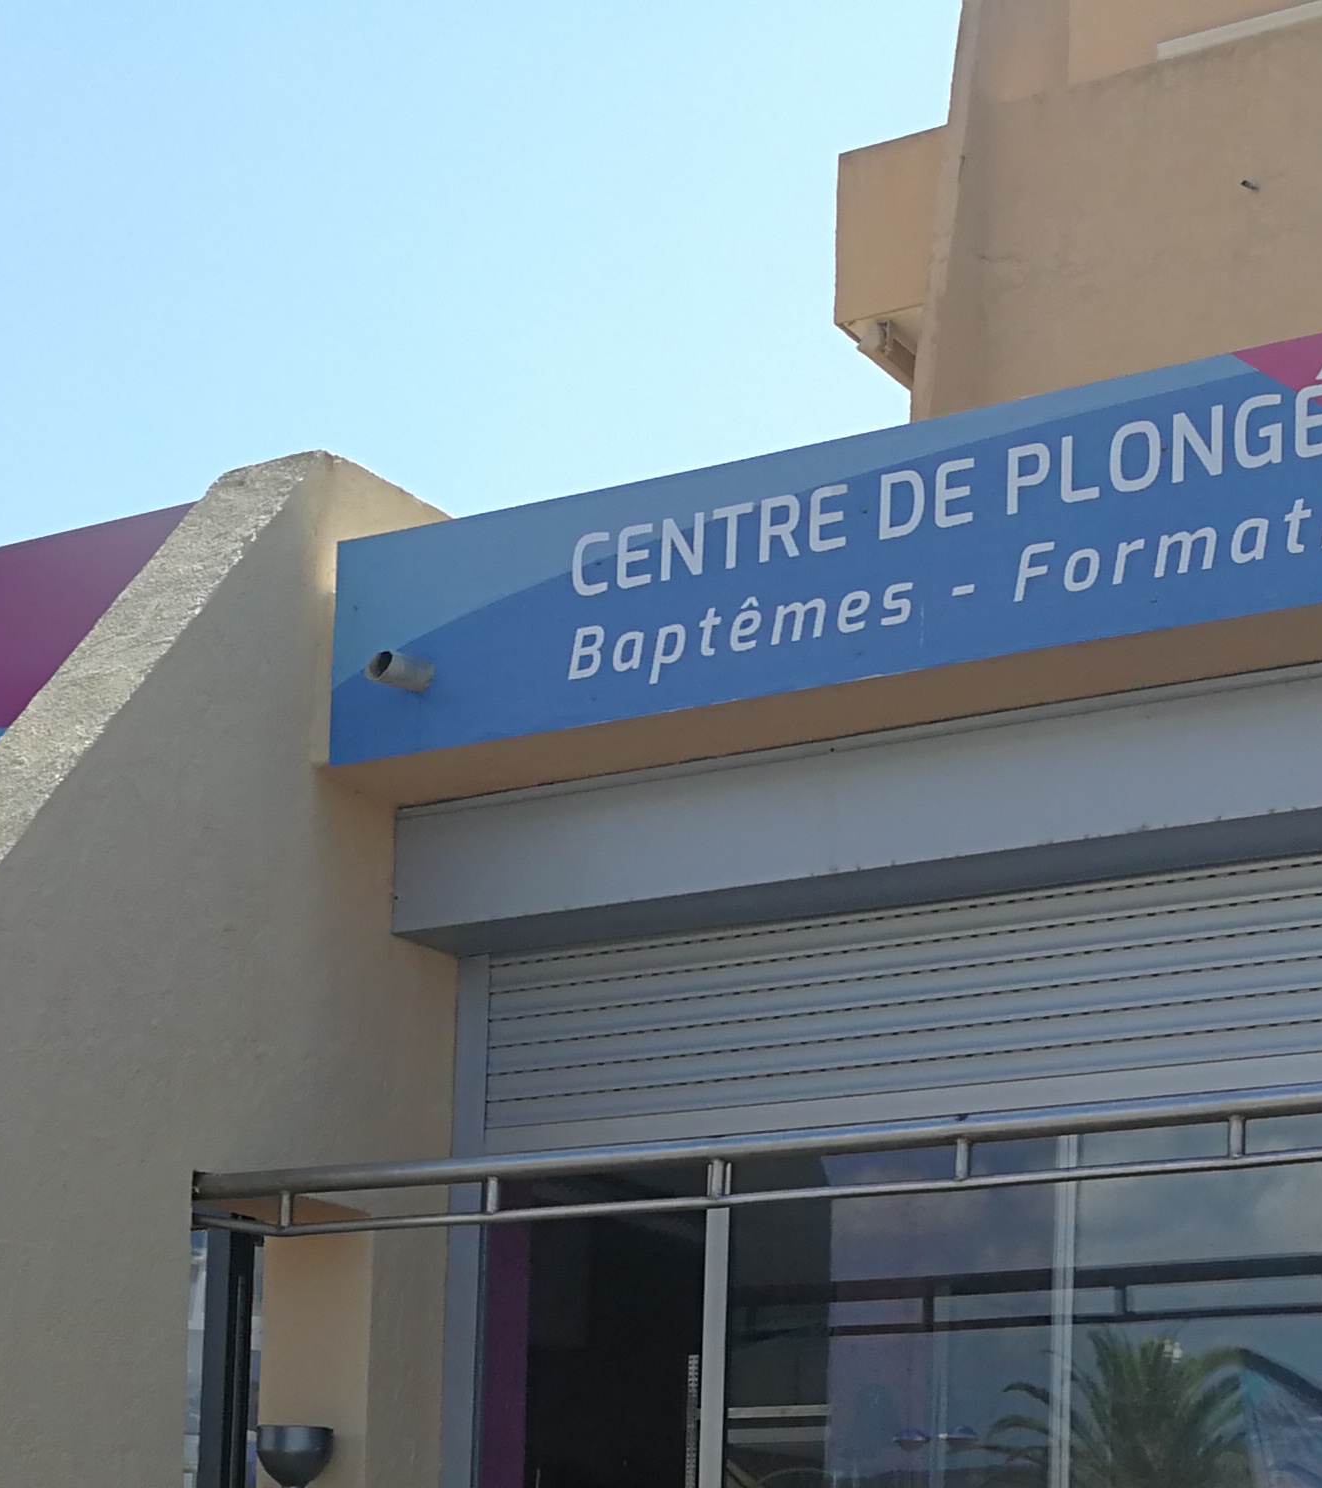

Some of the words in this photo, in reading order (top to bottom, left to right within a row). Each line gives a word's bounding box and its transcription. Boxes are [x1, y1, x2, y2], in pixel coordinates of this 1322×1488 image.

[570, 484, 849, 597] CENTRE
[877, 457, 976, 542] DE
[566, 578, 915, 685] Baptêmes
